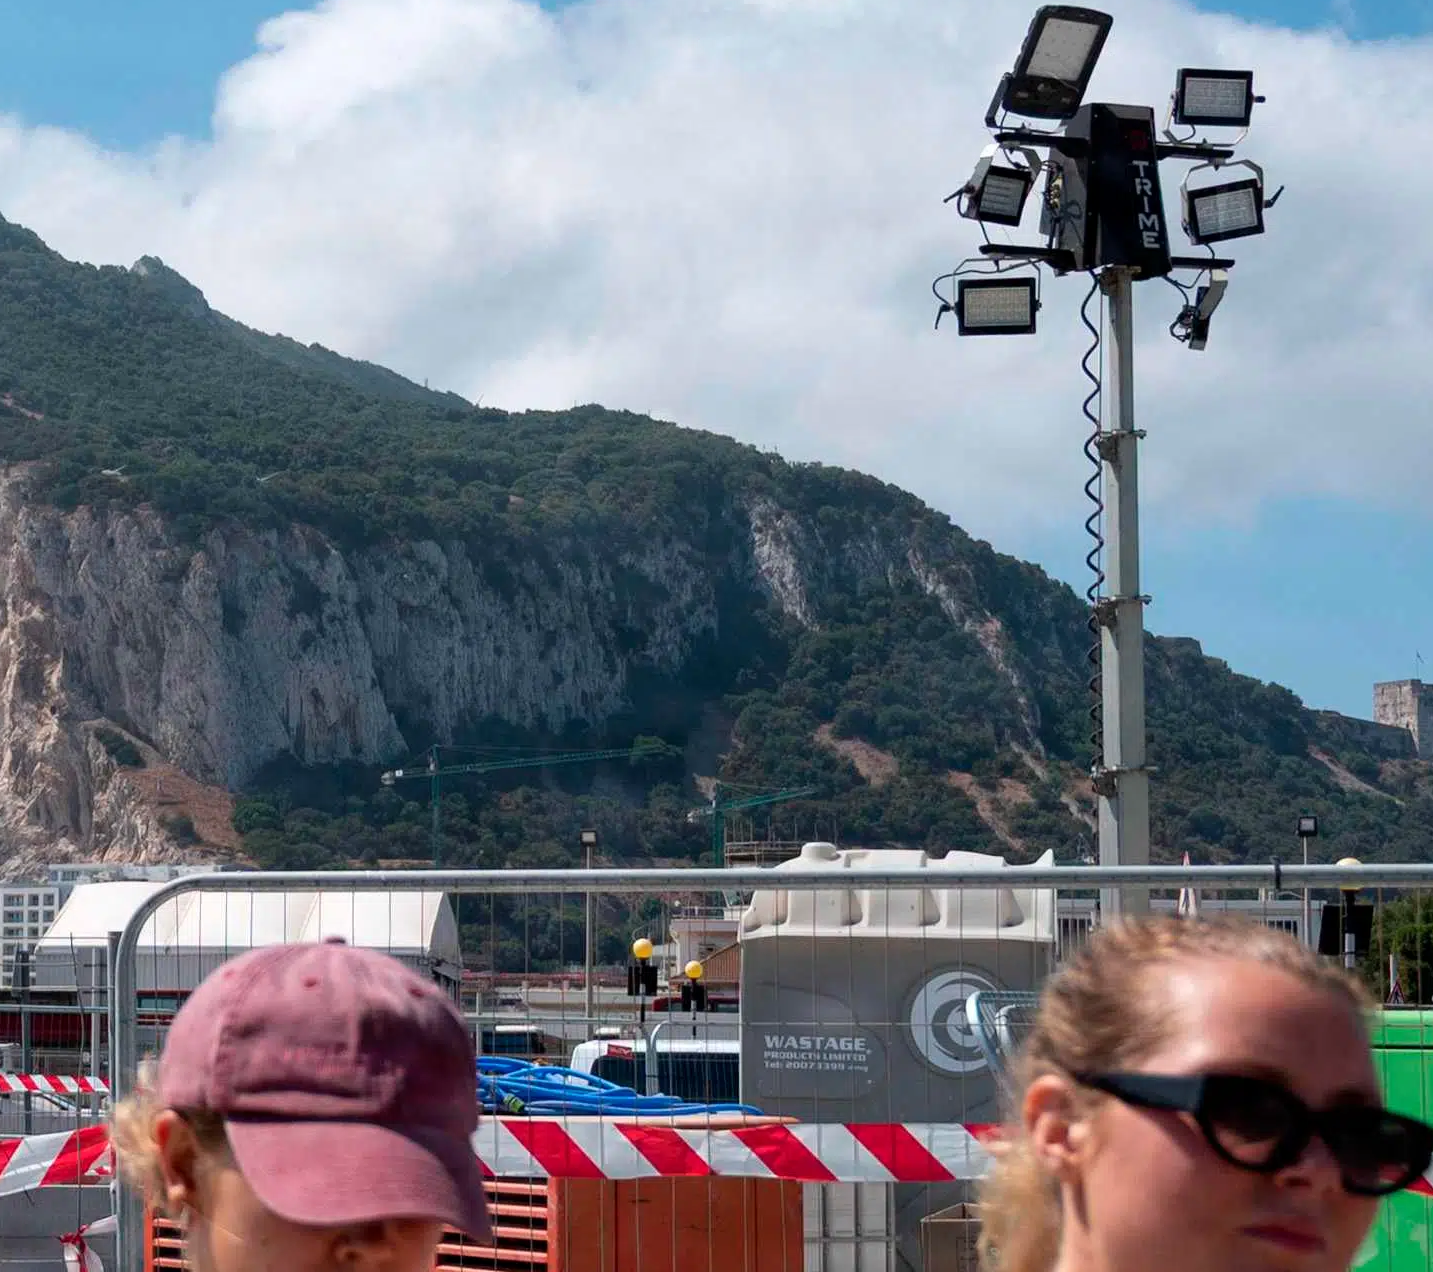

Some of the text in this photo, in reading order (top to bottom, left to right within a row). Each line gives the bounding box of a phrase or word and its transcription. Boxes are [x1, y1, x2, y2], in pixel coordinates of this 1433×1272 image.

[1131, 159, 1161, 249] TRIME
[763, 1034, 867, 1051] WASTAGE
[763, 1050, 867, 1062] PRODUCTS LIMITED
